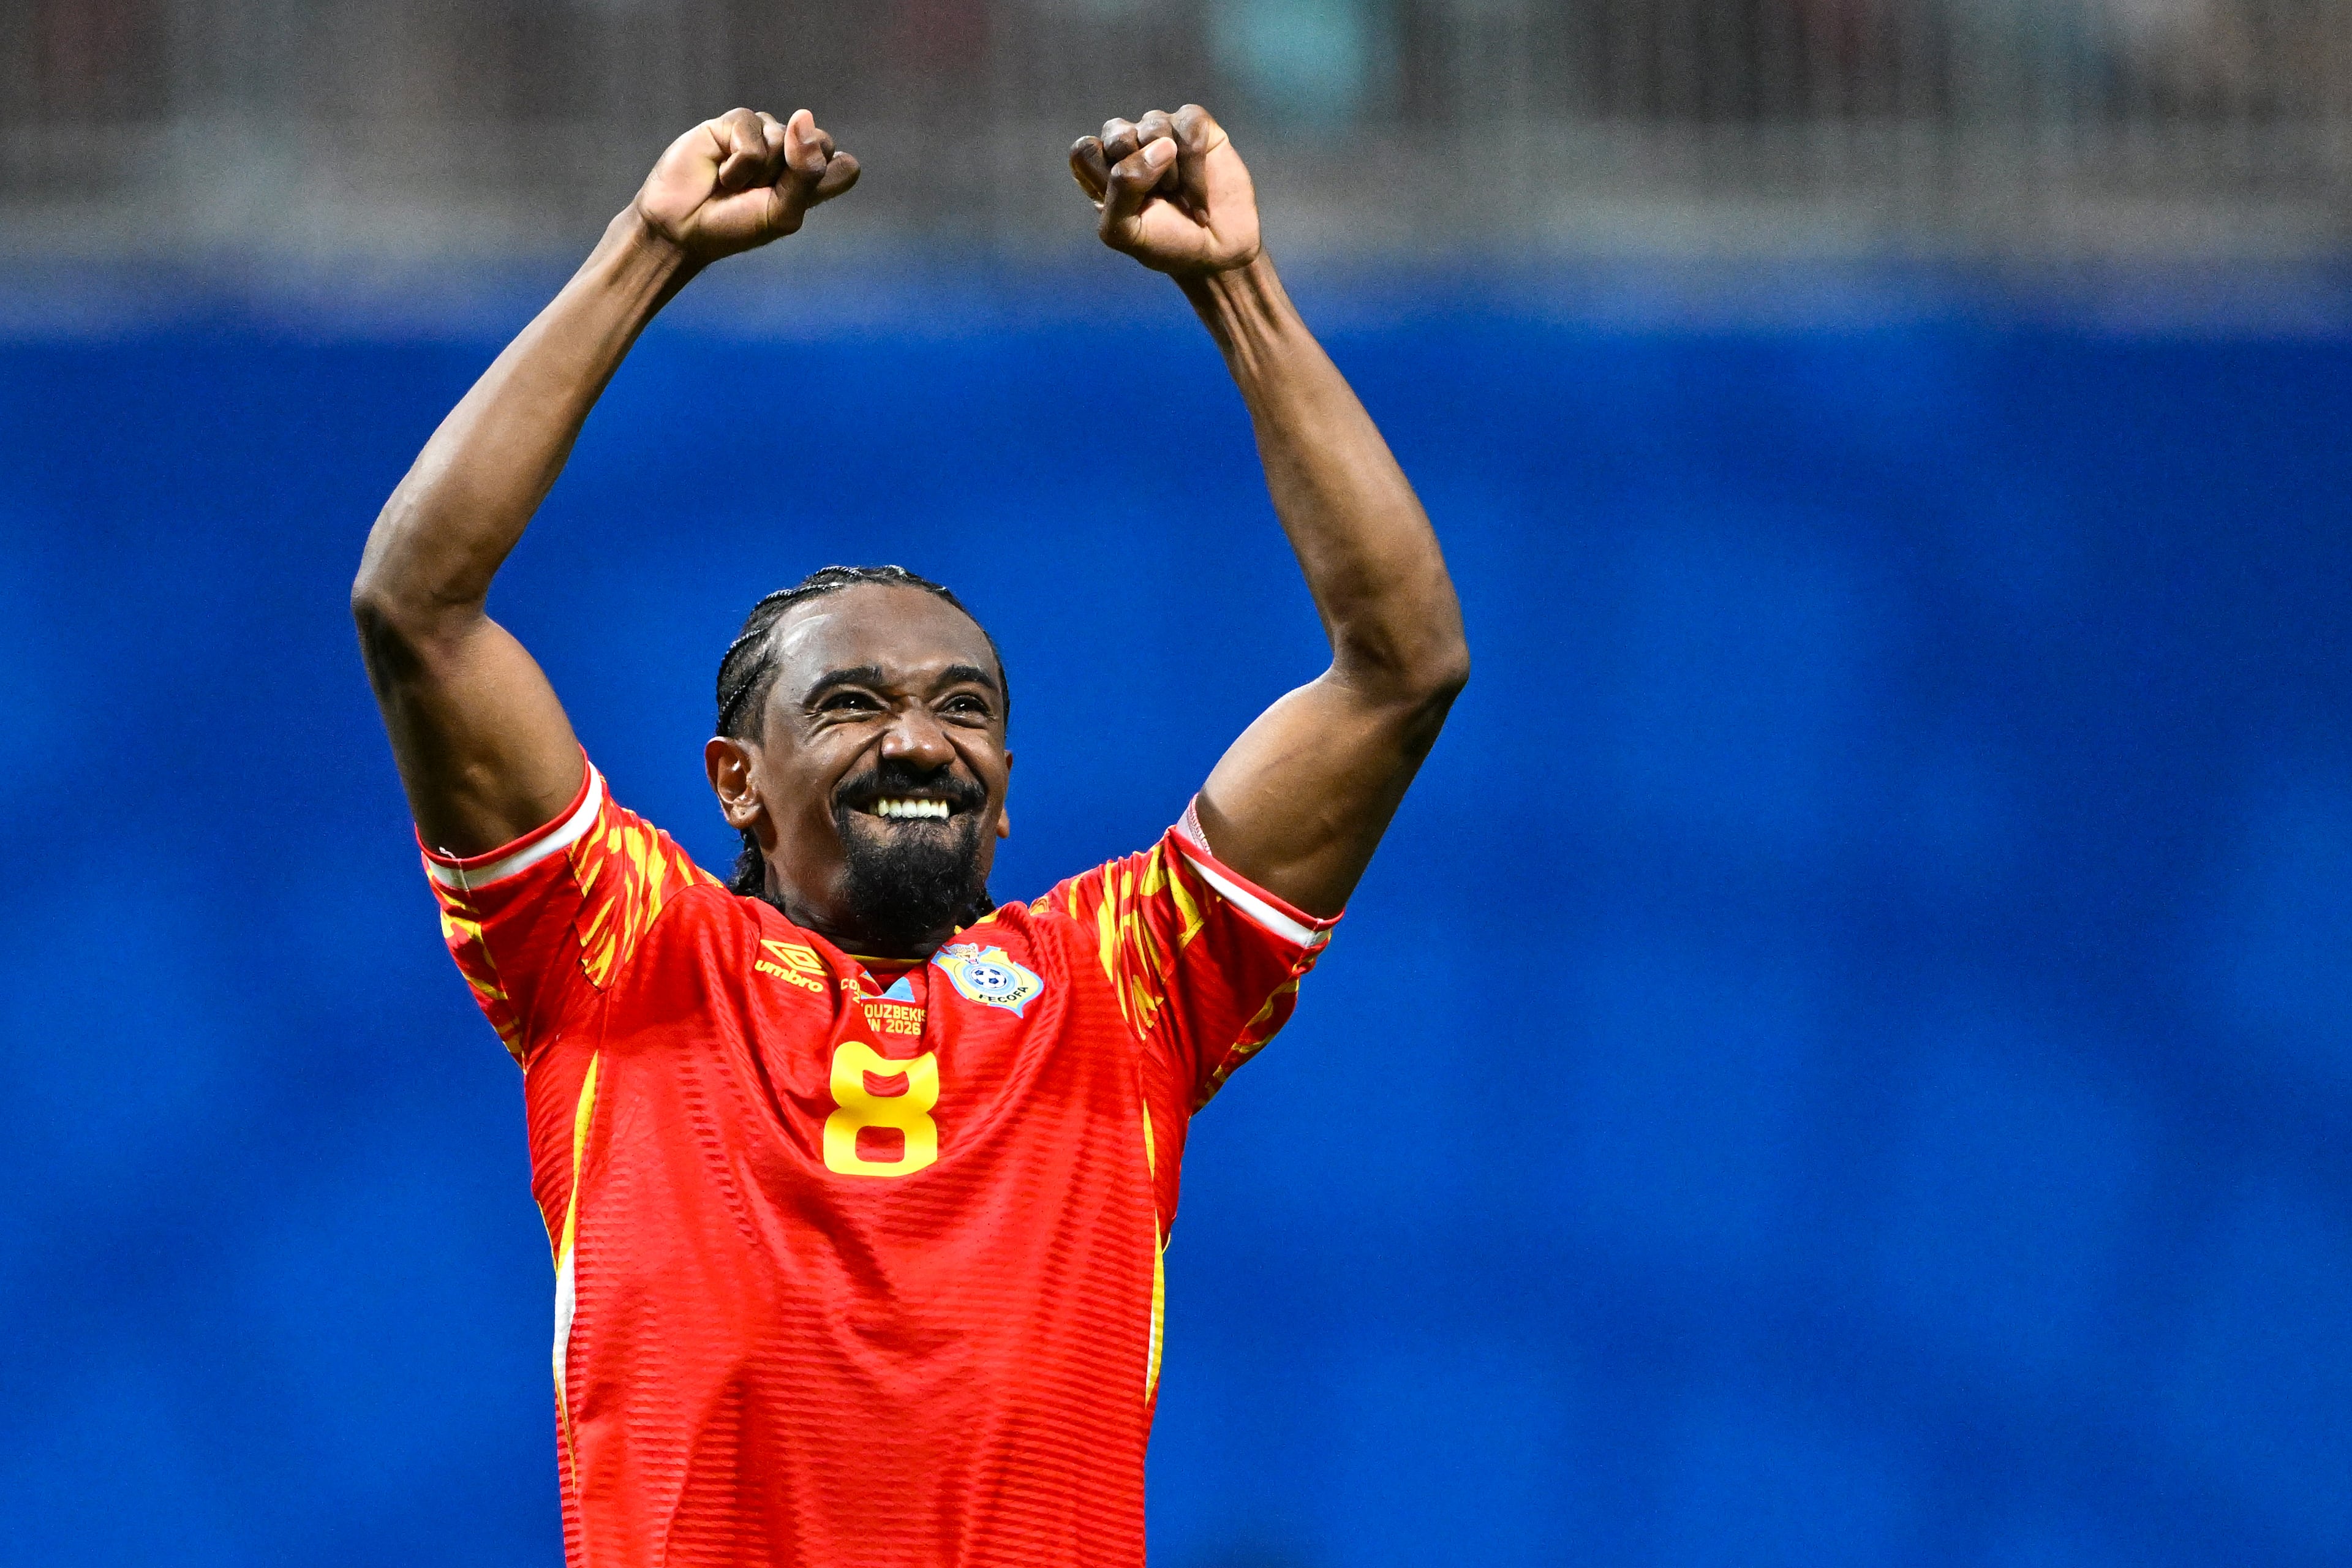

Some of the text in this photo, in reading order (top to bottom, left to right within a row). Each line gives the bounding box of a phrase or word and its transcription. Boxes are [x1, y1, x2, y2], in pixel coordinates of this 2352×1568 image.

[755, 960, 823, 992] umbro
[979, 986, 1028, 1003] FECOFA
[885, 1019, 921, 1035] 2026
[824, 1042, 939, 1177] 8
